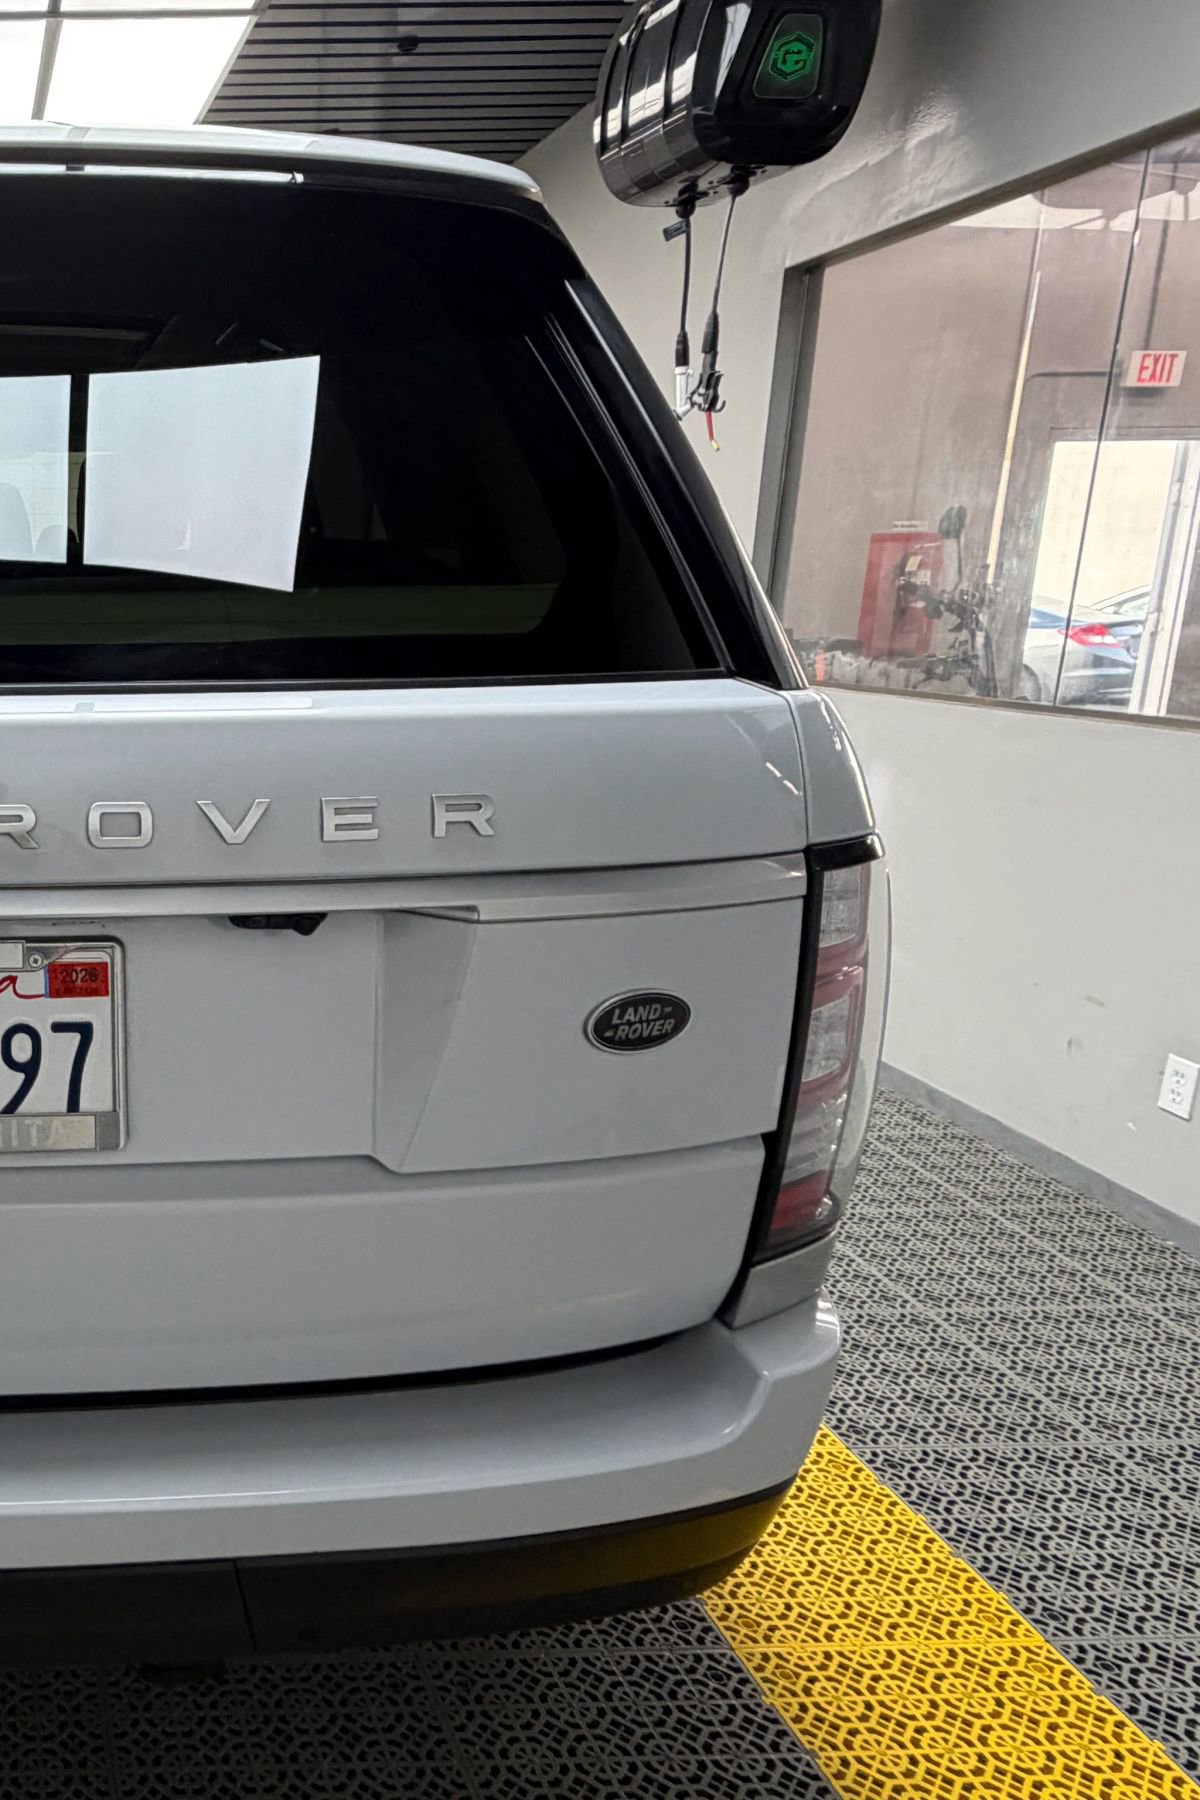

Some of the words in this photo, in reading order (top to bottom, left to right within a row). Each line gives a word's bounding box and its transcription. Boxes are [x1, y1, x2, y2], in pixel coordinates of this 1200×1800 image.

[1136, 353, 1179, 384] EXIT
[611, 1003, 662, 1025] LAND
[615, 1018, 676, 1042] ROVER
